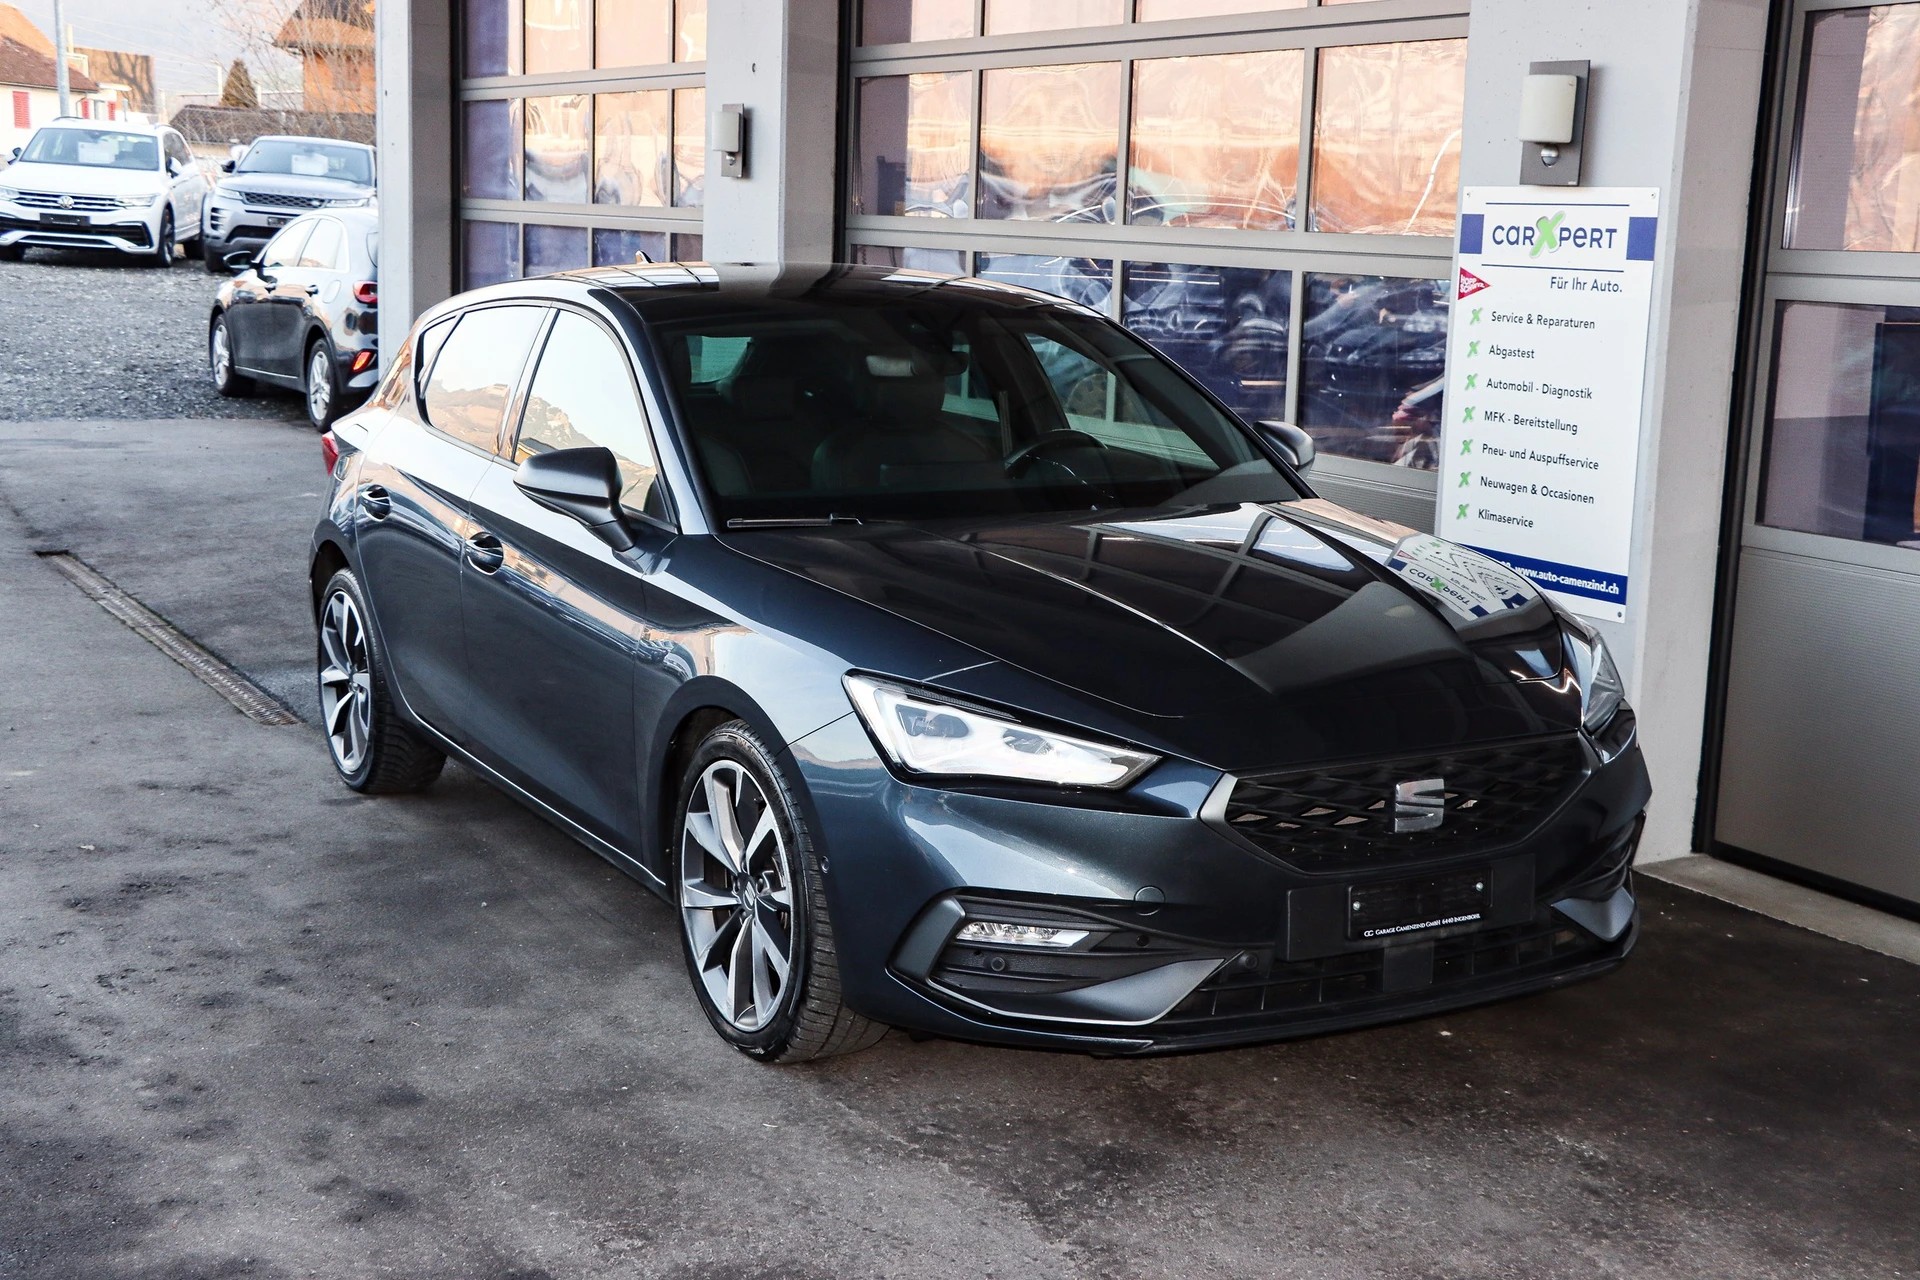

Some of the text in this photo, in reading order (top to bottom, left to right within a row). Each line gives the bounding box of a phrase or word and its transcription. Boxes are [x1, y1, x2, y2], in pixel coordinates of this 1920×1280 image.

[1550, 276, 1623, 293] Für Ihr Auto.
[1491, 311, 1596, 329] Service & Reparaturen
[1488, 345, 1535, 359] Abgastest
[1486, 378, 1533, 393] Automobil
[1542, 384, 1593, 400] Diagnostik
[1484, 411, 1505, 423] MFK
[1513, 414, 1578, 435] Bereitstellung
[1482, 443, 1599, 470] Pneu- und Auspuffservice
[1480, 476, 1594, 504] Neuwagen & Occasionen
[1478, 509, 1534, 528] Klimaservice
